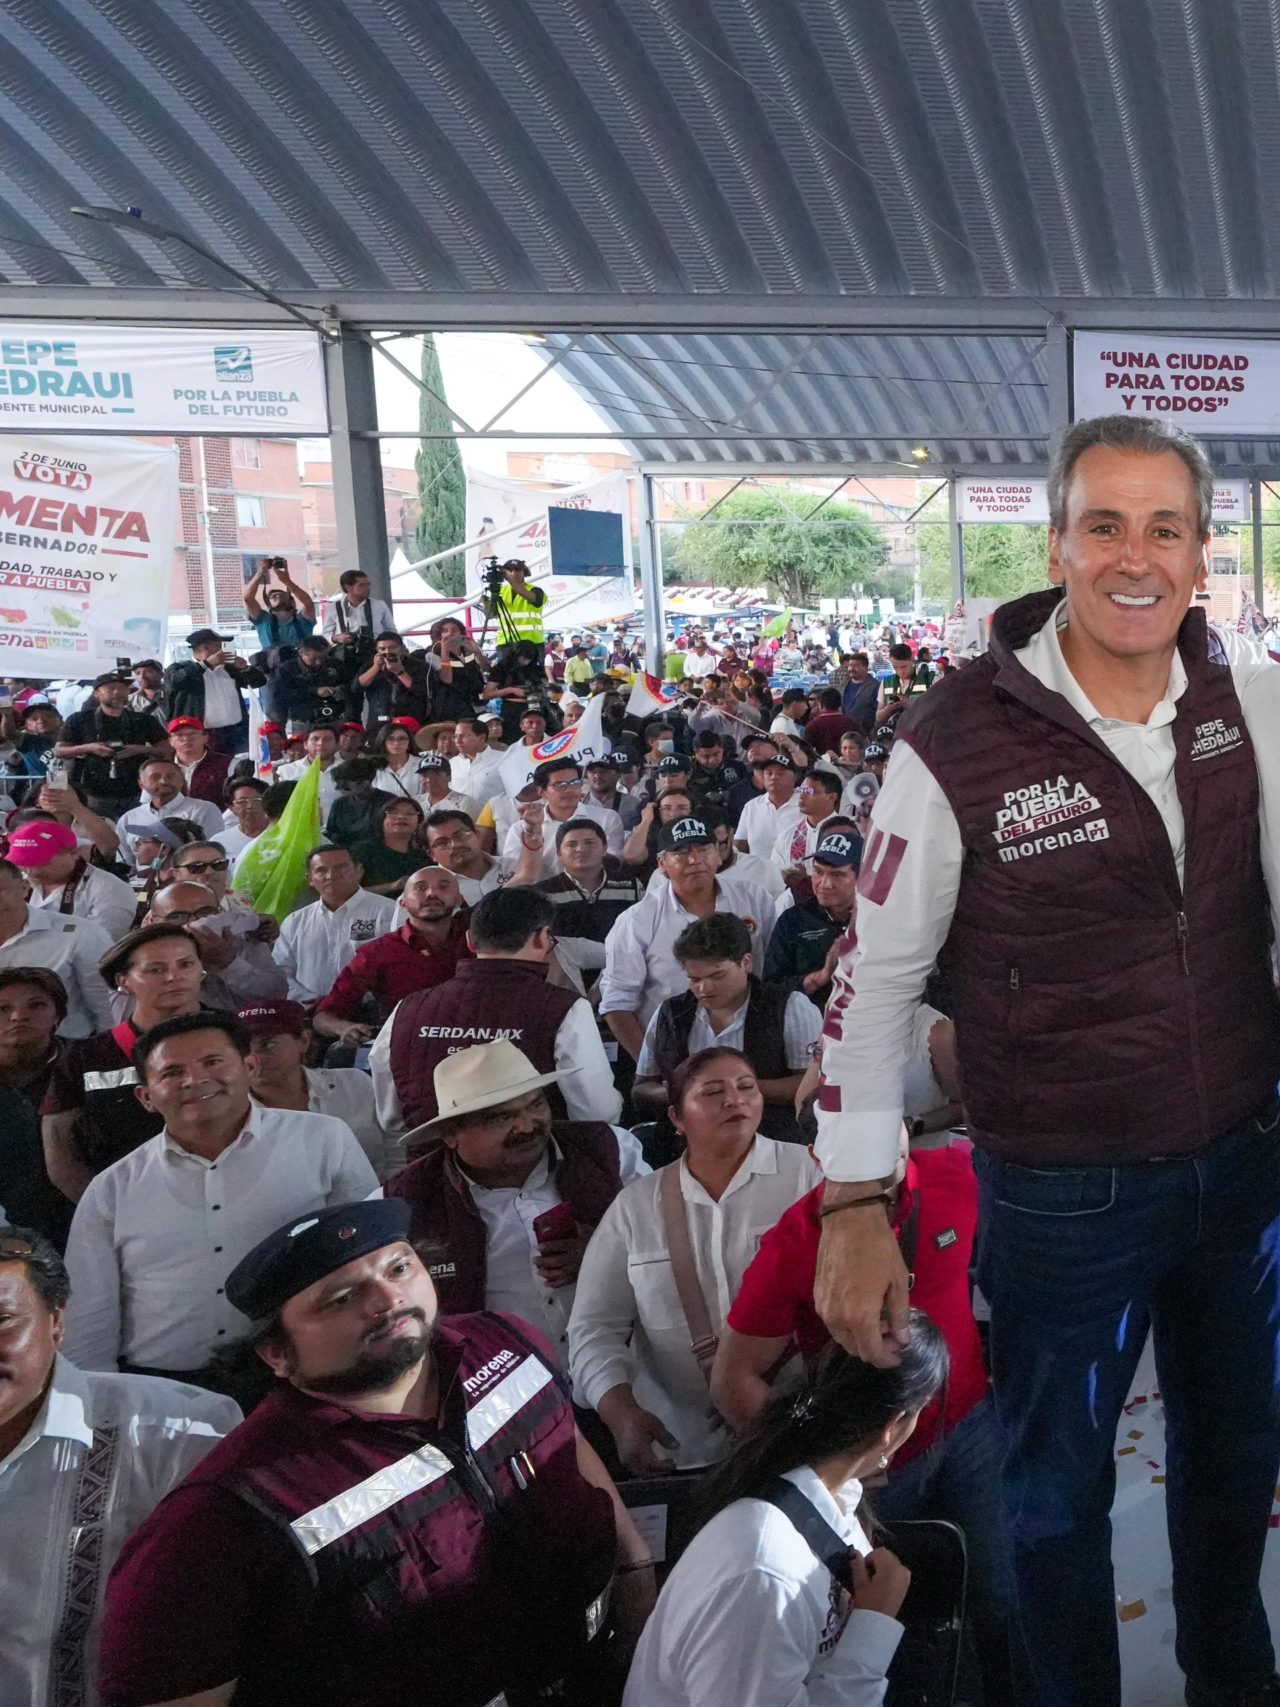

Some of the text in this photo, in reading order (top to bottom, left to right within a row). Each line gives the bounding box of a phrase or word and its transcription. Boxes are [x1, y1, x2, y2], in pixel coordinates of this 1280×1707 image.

[1, 340, 78, 366] EPE
[1100, 351, 1249, 371] “UNA CIUDAD
[217, 371, 252, 382] alianza
[1105, 373, 1245, 392] PARA TODAS
[173, 389, 300, 402] POR LA PUEBLA
[1121, 395, 1229, 413] Y TODOS”
[39, 404, 108, 414] MUNICIPAL
[188, 404, 289, 416] DEL FUTURO
[20, 451, 87, 472] 2 DE JUNIO
[15, 461, 88, 490] VOTA
[996, 486, 1032, 494] CIUDAD
[0, 490, 151, 543] MENTA
[0, 560, 118, 582] DAD, TRABAJO Y
[12, 575, 22, 586] A
[26, 577, 87, 592] PUEBLA
[0, 634, 34, 648] ena
[1195, 718, 1226, 739] PEPE
[1003, 774, 1071, 807] POR LA
[996, 782, 1090, 829] PUEBLA
[1000, 800, 1093, 841] DEL FUTURO
[673, 829, 707, 841] PUEBLA
[818, 845, 847, 856] PUEBLA
[998, 826, 1105, 863] morena PT
[238, 1007, 277, 1018] orena
[419, 1026, 525, 1041] SERDAN.MX
[430, 1262, 456, 1275] ena
[462, 1349, 514, 1392] morena
